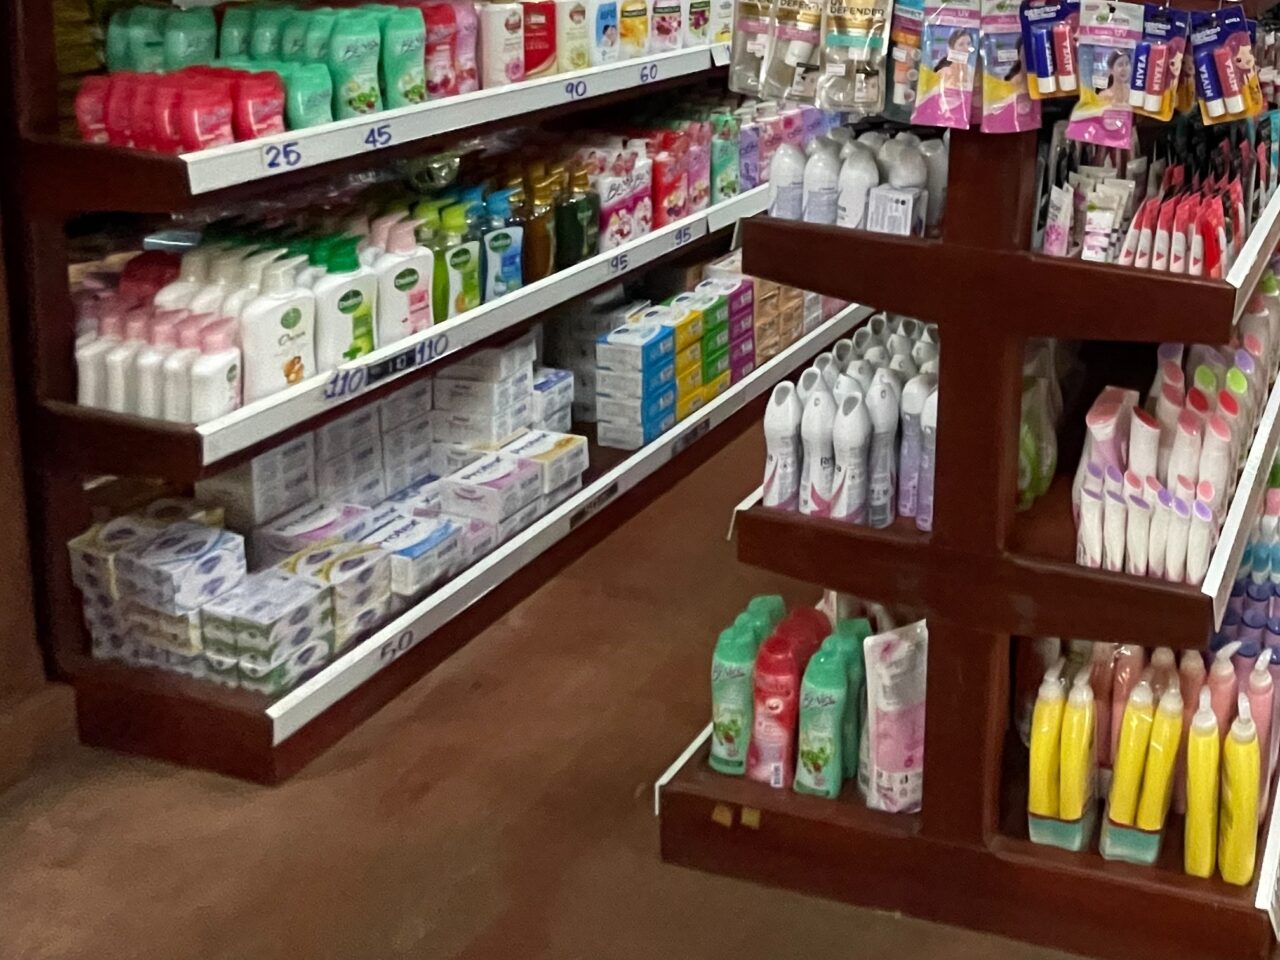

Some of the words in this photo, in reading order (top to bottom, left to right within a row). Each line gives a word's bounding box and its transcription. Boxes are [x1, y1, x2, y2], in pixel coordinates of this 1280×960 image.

[830, 5, 885, 17] DEFENDER
[639, 63, 659, 83] 60
[1135, 54, 1147, 87] NIVEA
[1153, 59, 1164, 91] NIVEA
[1199, 64, 1214, 98] NIVEA
[1225, 58, 1239, 92] NIVEA
[564, 80, 588, 99] 90
[364, 124, 393, 148] 45
[265, 141, 302, 168] 25
[674, 227, 692, 245] 95
[611, 254, 630, 270] 95
[416, 333, 449, 360] 110
[324, 367, 365, 400] 110
[379, 629, 414, 664] 50
